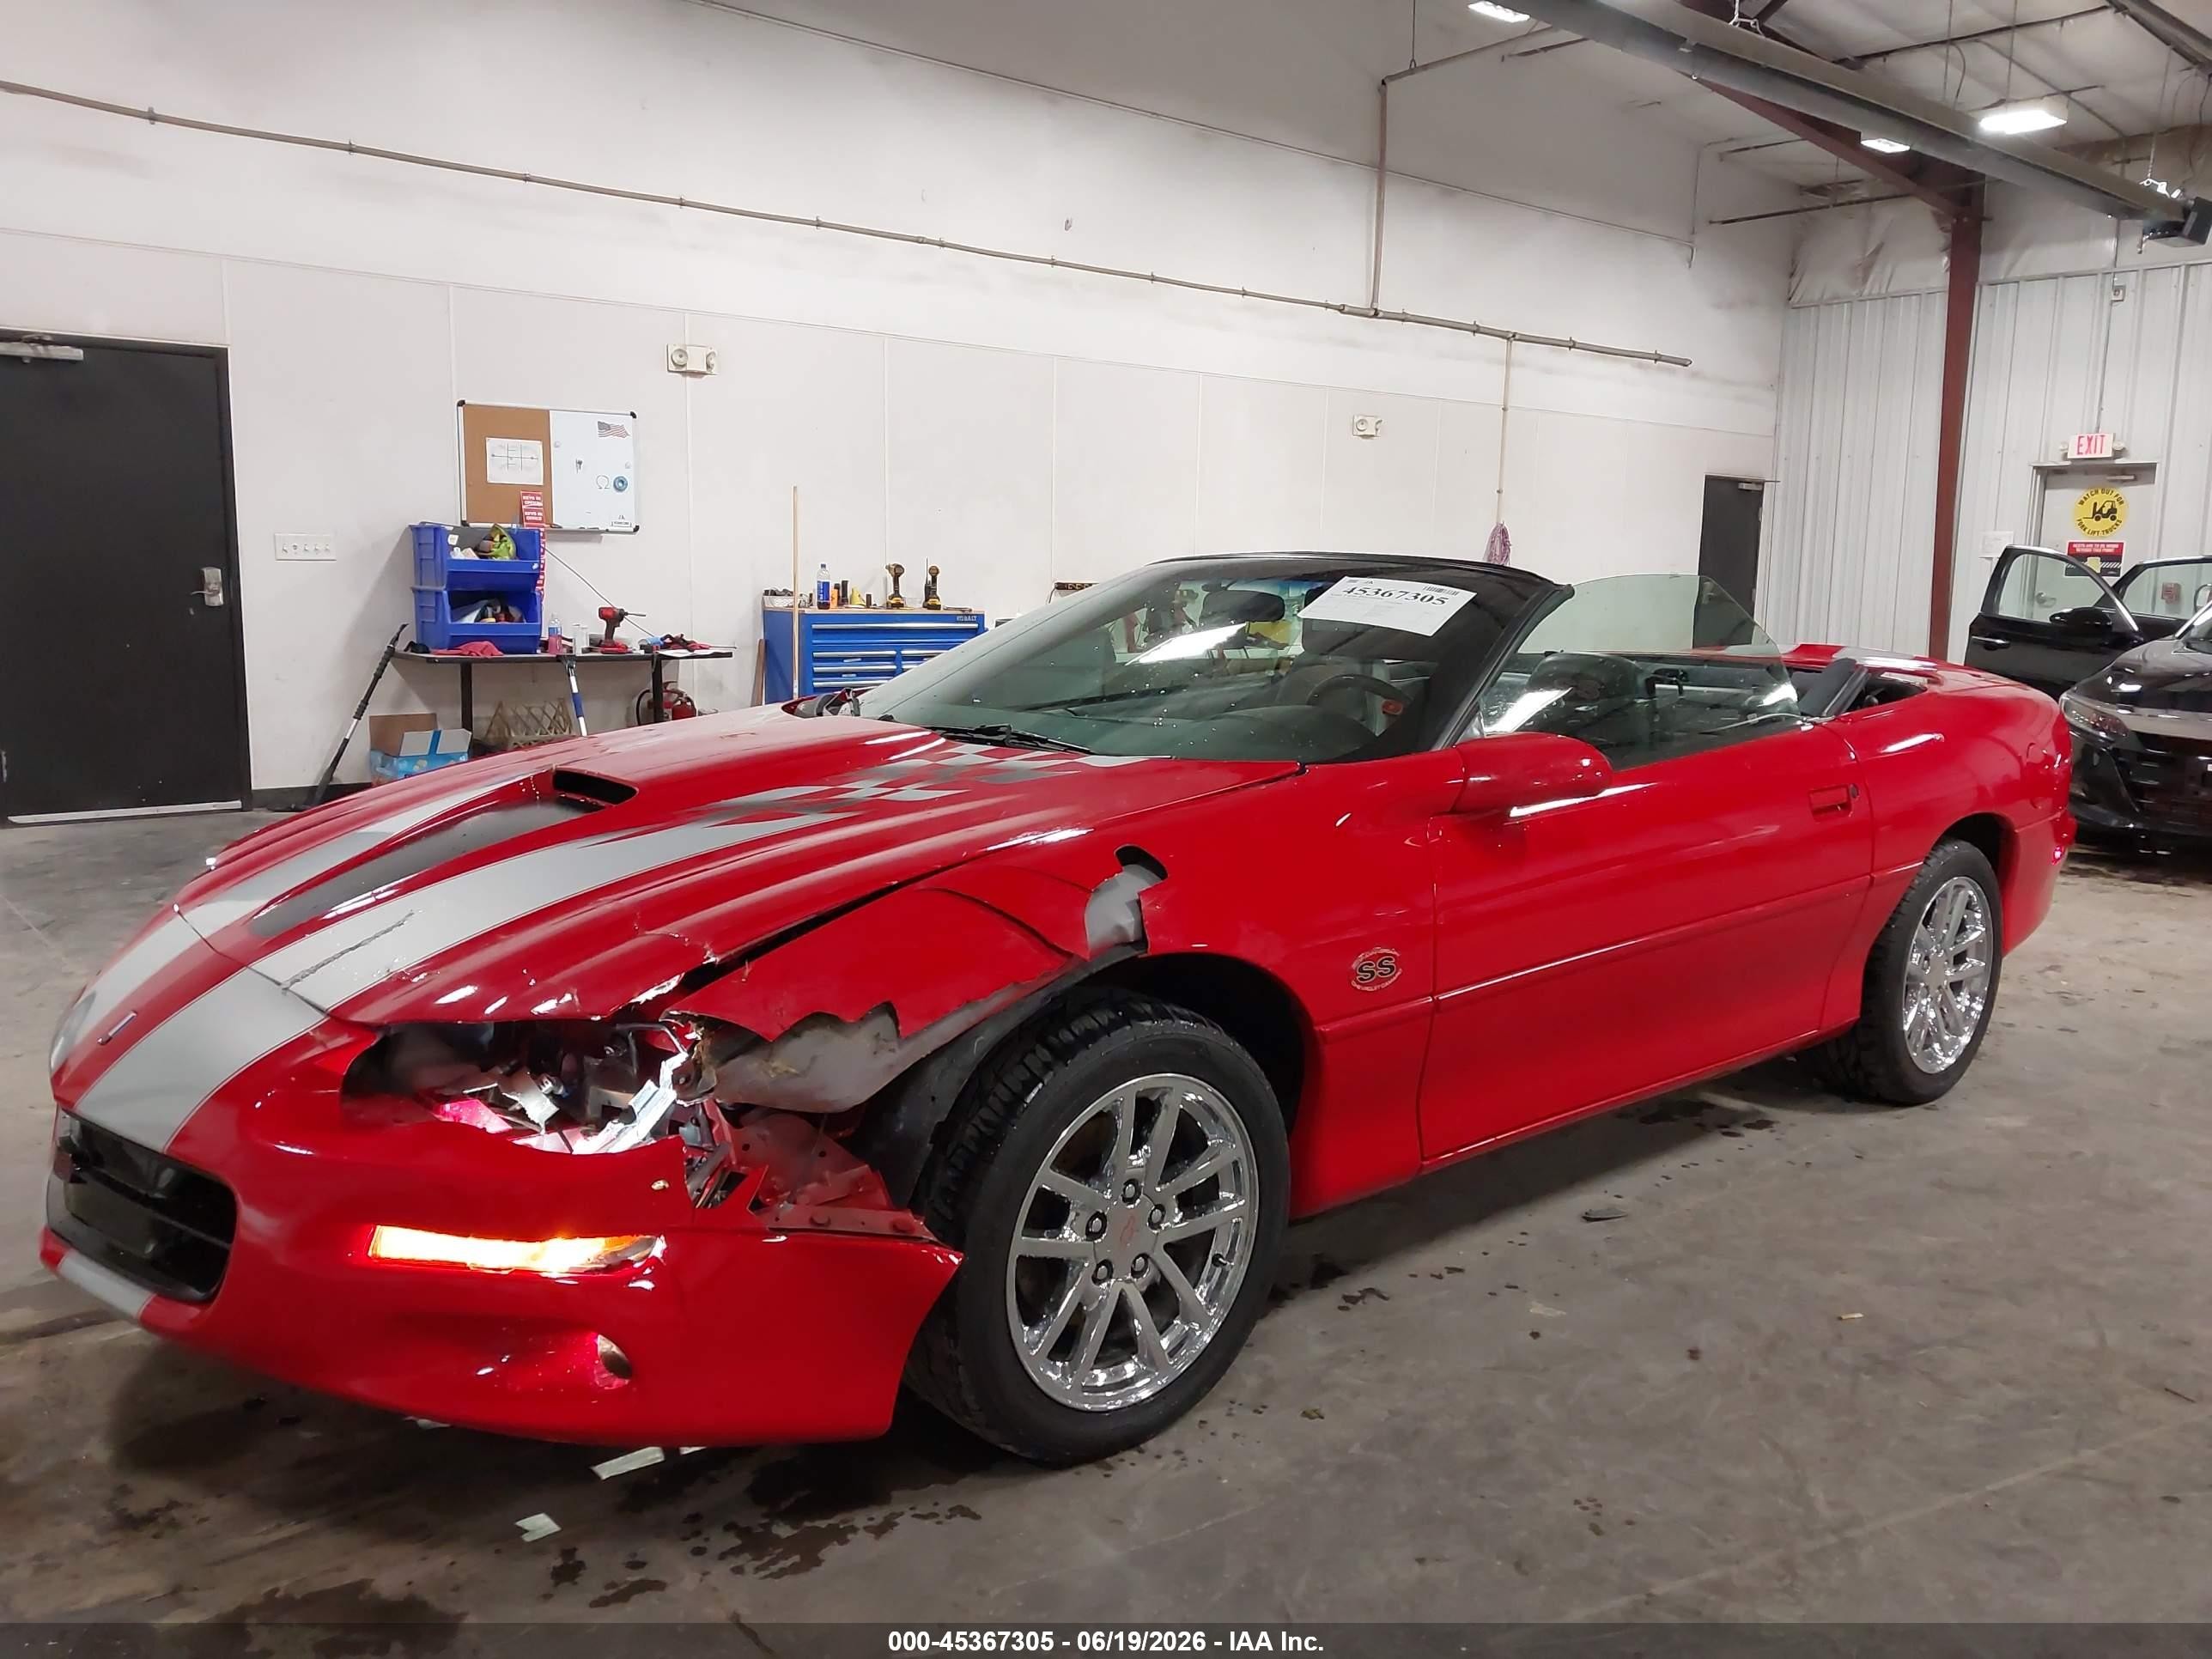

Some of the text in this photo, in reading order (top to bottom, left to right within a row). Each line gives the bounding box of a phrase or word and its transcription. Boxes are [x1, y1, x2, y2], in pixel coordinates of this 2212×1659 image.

[2077, 434, 2106, 455] EXIT
[2078, 488, 2124, 506] WATCH OUT FOR
[2076, 518, 2123, 537] FORK LIFT TRUCKS
[1343, 586, 1449, 605] 45367305
[1356, 956, 1396, 983] SS
